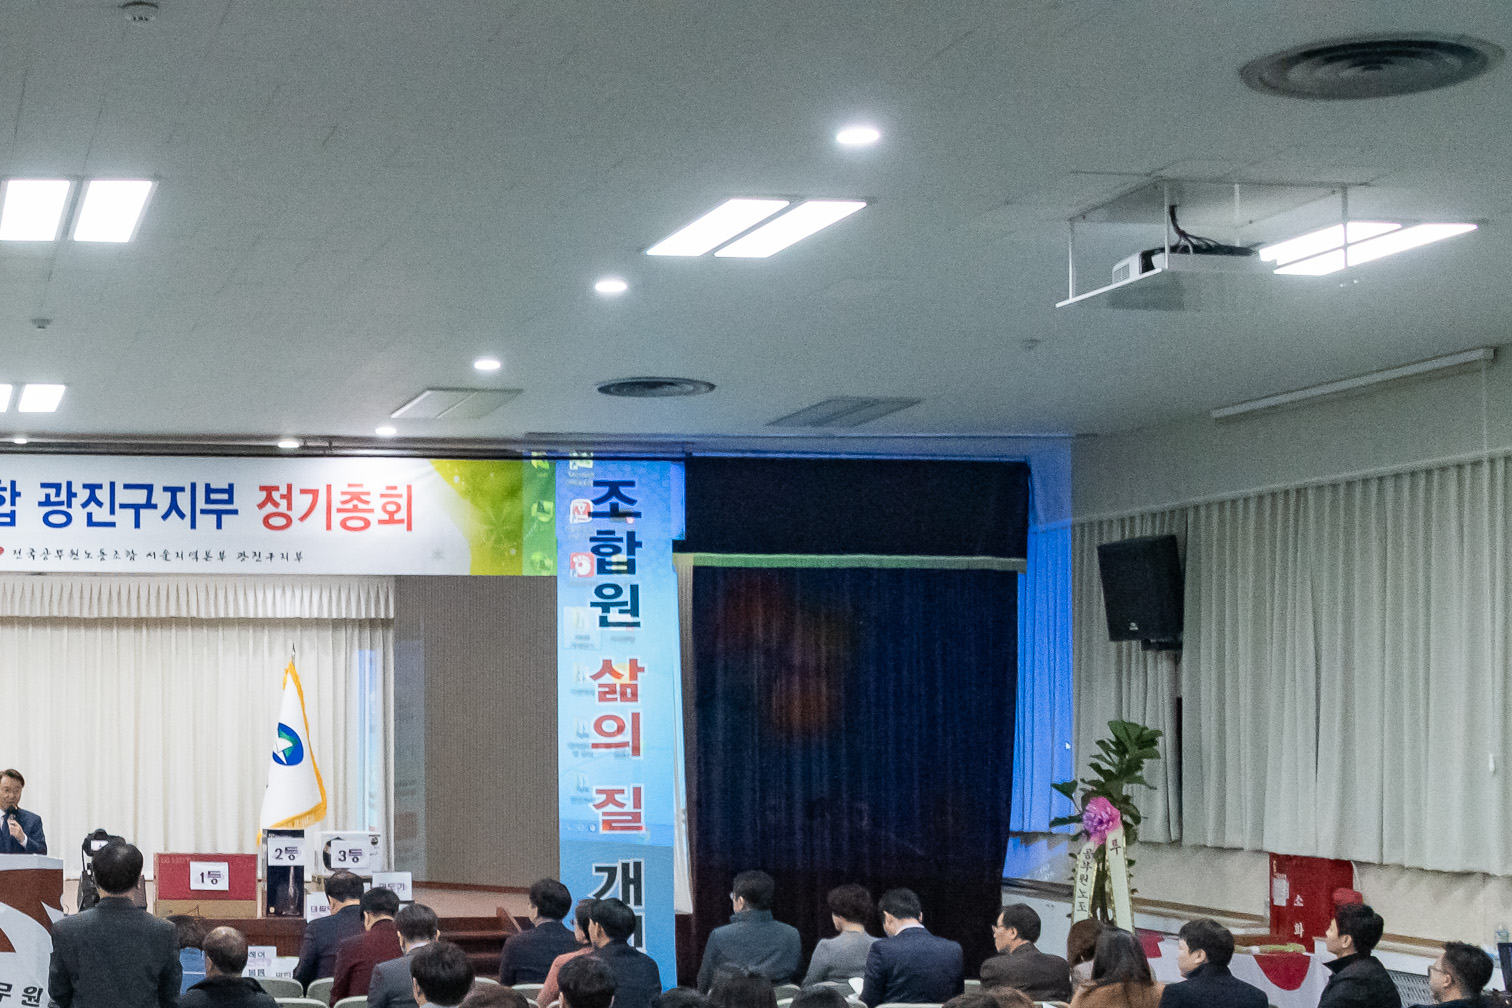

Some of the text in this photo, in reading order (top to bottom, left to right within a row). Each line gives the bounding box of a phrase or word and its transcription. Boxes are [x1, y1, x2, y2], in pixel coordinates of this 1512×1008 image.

[37, 479, 239, 530] 광진구지부
[256, 482, 414, 532] 정기총회
[13, 548, 304, 563] 전국공무원노동조합 서울지역본부 광진구지부
[587, 480, 646, 949] 조합원 삶의 질 개
[274, 846, 299, 861] 2등
[337, 849, 363, 863] 3등
[199, 870, 222, 885] 1등
